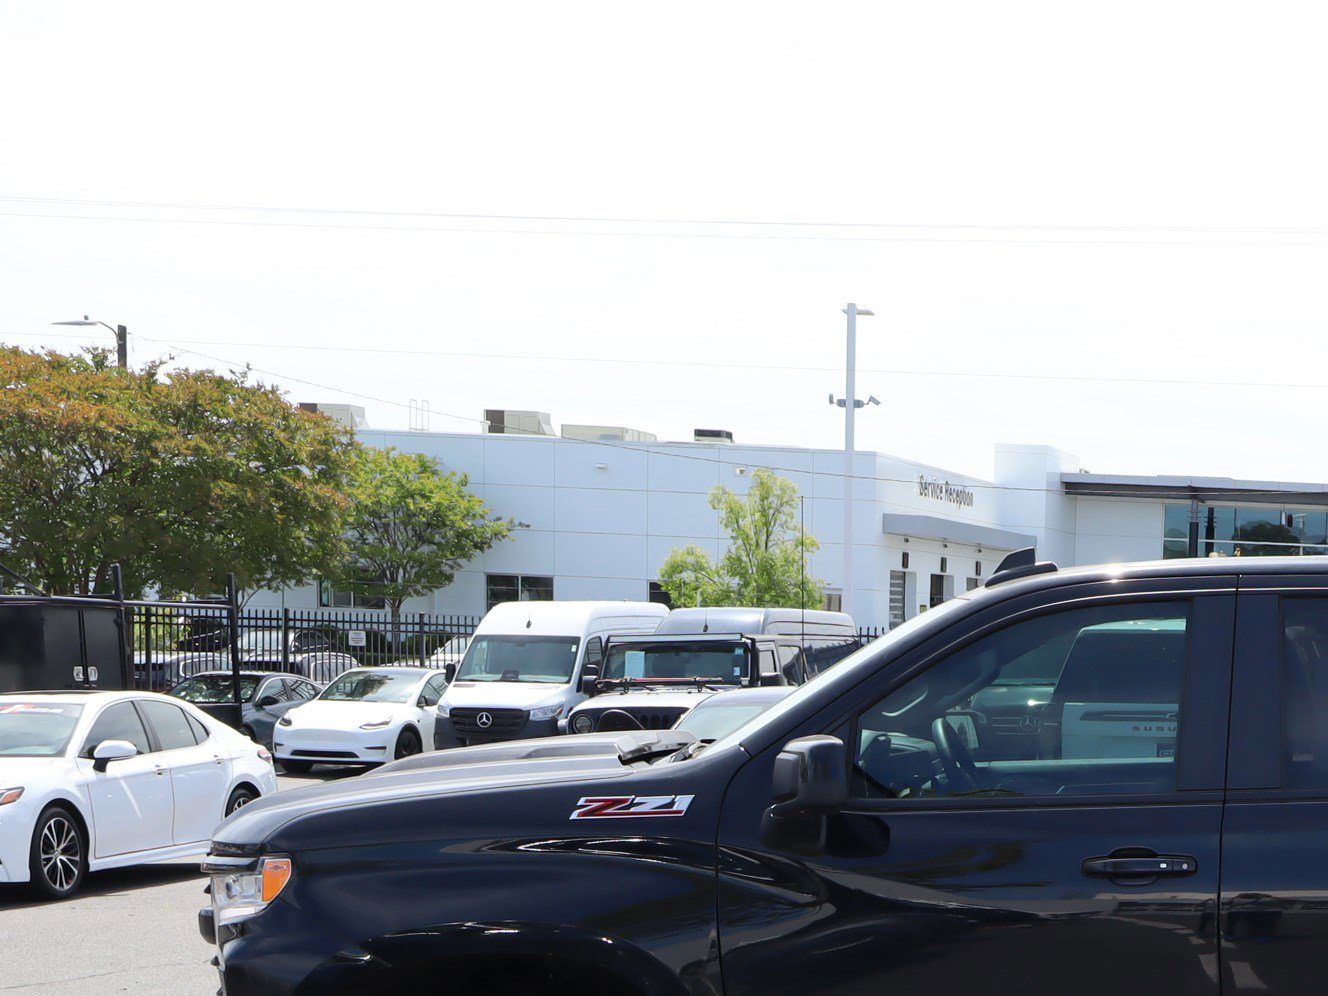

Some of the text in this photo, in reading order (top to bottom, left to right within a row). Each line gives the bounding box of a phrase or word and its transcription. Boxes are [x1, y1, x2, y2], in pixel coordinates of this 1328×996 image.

[920, 474, 973, 509] Service Reception
[569, 794, 695, 820] Z71
